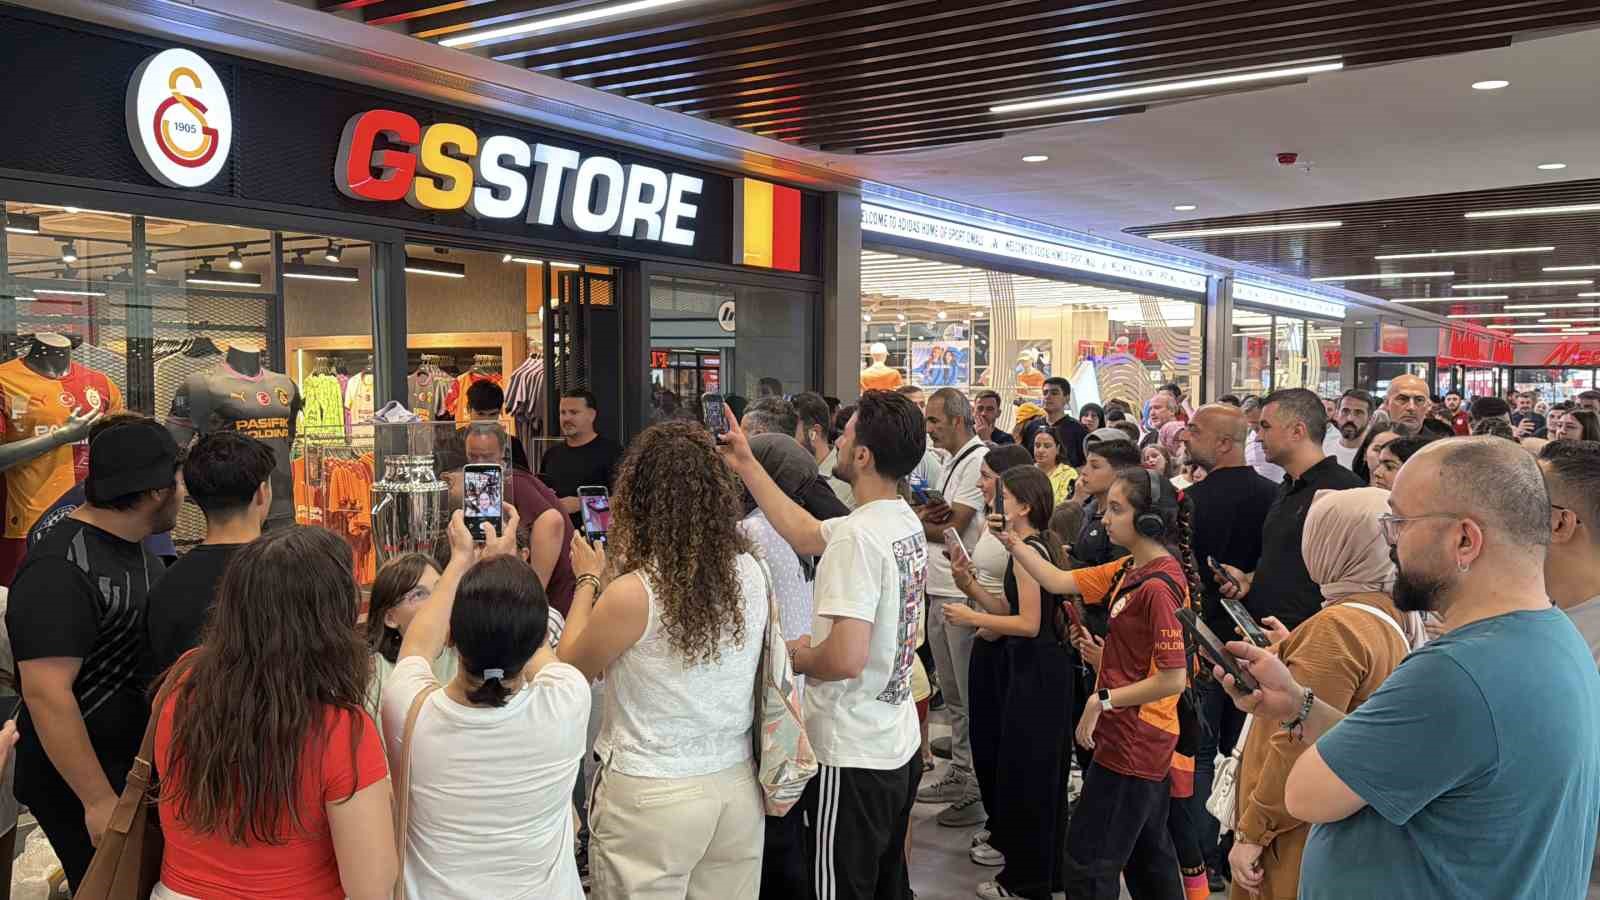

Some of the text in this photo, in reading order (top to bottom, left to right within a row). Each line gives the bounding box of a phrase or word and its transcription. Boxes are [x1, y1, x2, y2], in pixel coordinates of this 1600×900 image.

[174, 121, 197, 134] 1905
[861, 209, 888, 228] ELCOME
[897, 216, 920, 234] ADIDAS
